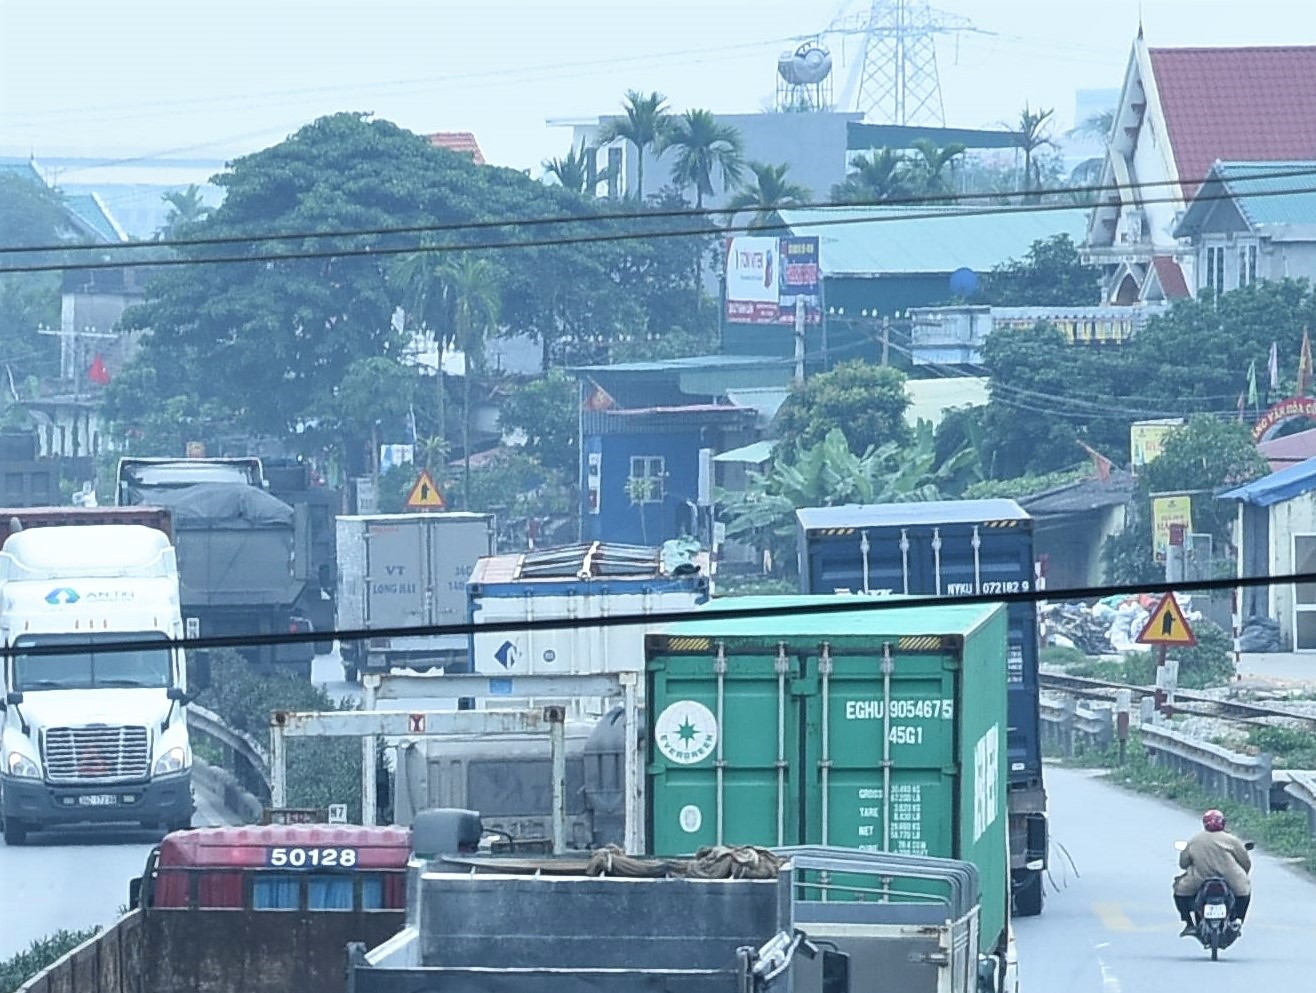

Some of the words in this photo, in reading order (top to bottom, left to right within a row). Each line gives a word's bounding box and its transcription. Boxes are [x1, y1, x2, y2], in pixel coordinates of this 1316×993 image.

[846, 701, 883, 720] EGHU
[889, 699, 953, 720] 9054675
[888, 726, 923, 745] 45G1
[858, 825, 874, 836] NET
[270, 848, 357, 867] 50128
